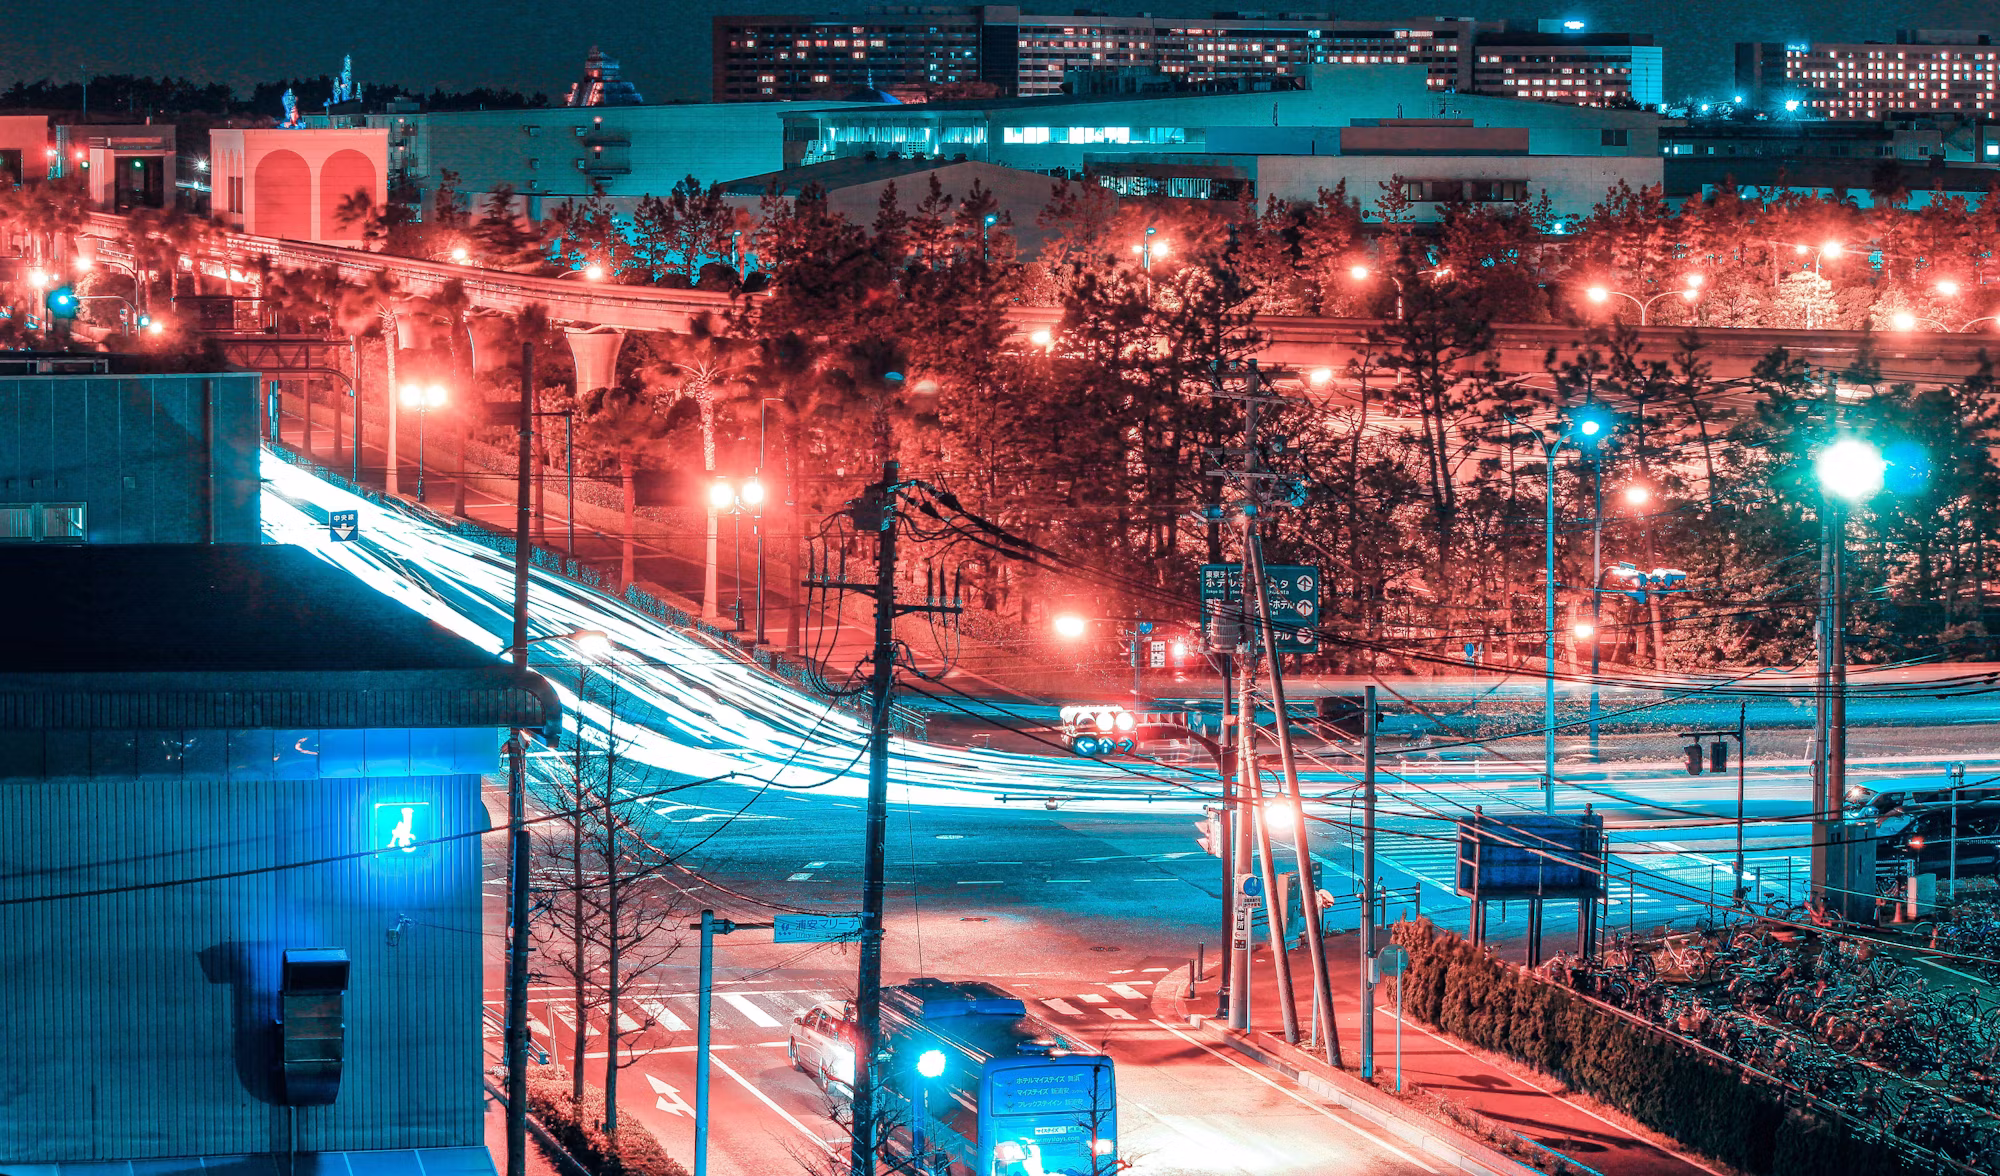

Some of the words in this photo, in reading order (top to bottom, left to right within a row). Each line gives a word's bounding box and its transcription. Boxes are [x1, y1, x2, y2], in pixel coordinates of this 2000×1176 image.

[333, 513, 355, 522] 中央線
[795, 919, 858, 931] 浦安マリーナ
[1016, 1075, 1065, 1085] ホテルマイステイズ
[1017, 1088, 1048, 1096] マイステイズ
